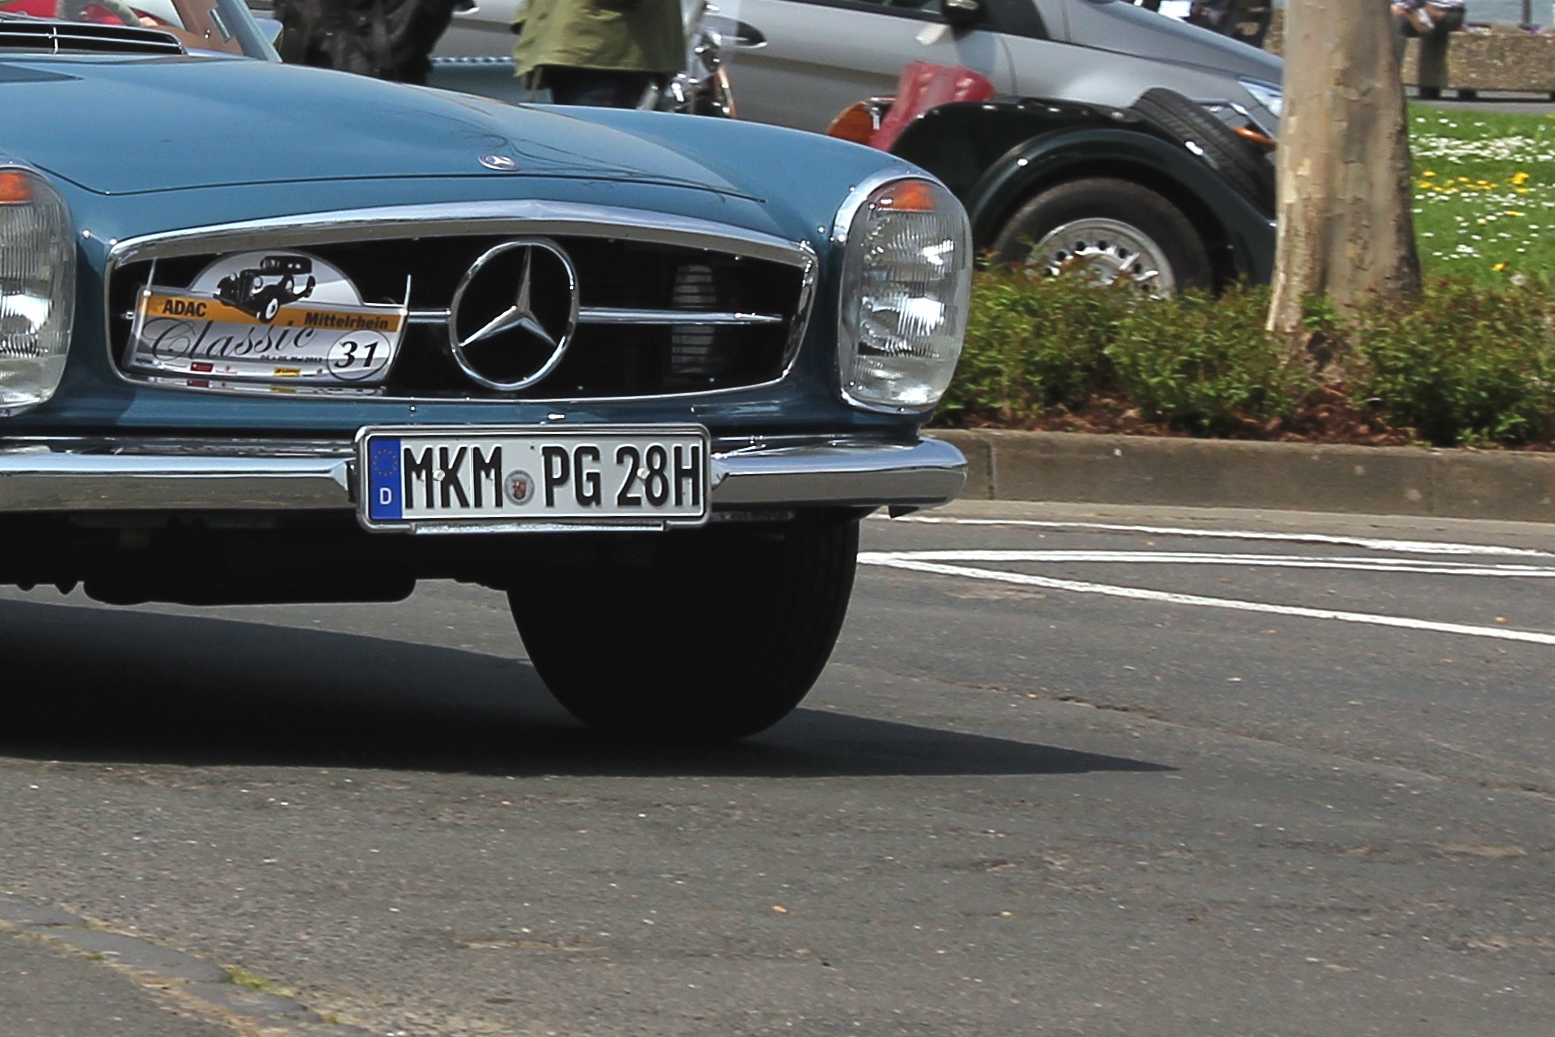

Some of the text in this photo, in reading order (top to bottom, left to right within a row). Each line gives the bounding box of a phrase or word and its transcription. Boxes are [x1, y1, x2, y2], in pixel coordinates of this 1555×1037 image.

[163, 299, 207, 317] ADAC
[304, 312, 389, 330] Mittelrhein
[142, 316, 318, 361] Classic
[334, 341, 379, 368] 31
[403, 444, 701, 508] MKM PG 28H
[379, 487, 393, 505] D
